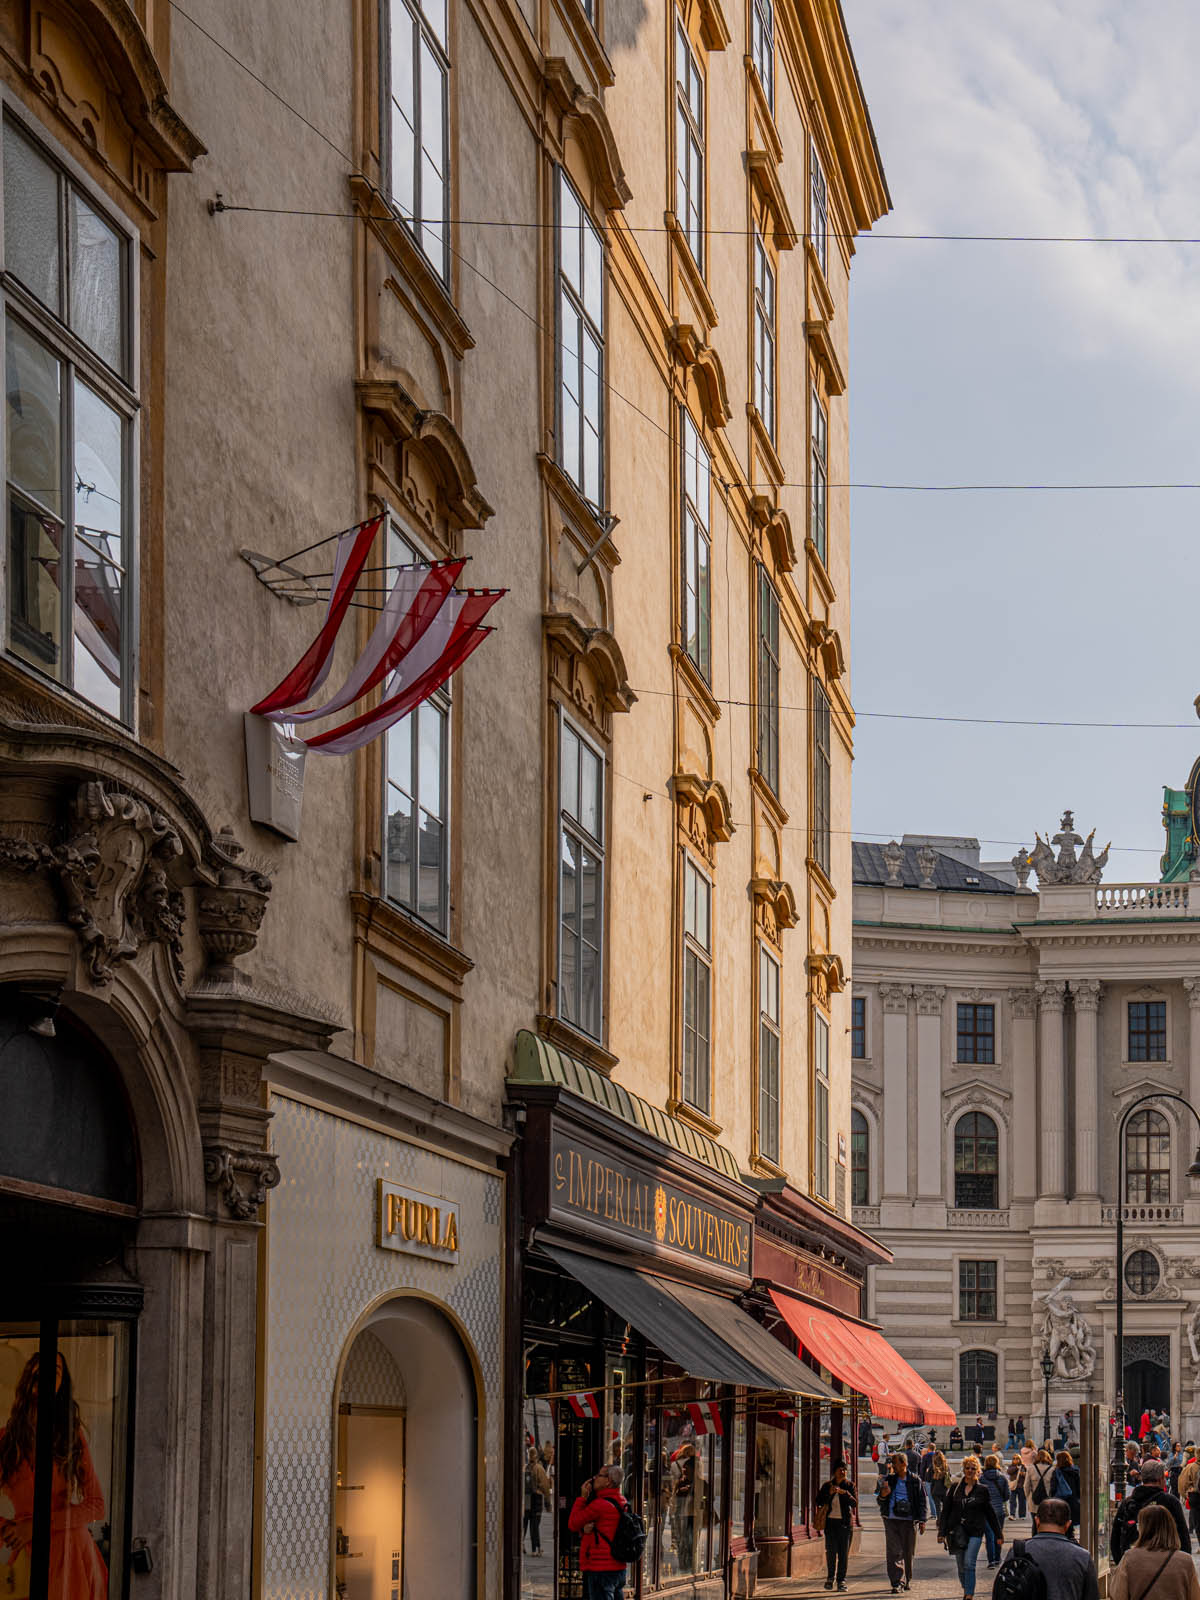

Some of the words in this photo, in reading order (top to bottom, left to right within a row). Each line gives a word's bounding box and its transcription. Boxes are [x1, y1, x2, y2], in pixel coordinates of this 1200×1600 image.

[387, 1193, 459, 1251] FURLA
[568, 1150, 652, 1233] IMPERIAL
[669, 1197, 742, 1268] SOUVENIRS
